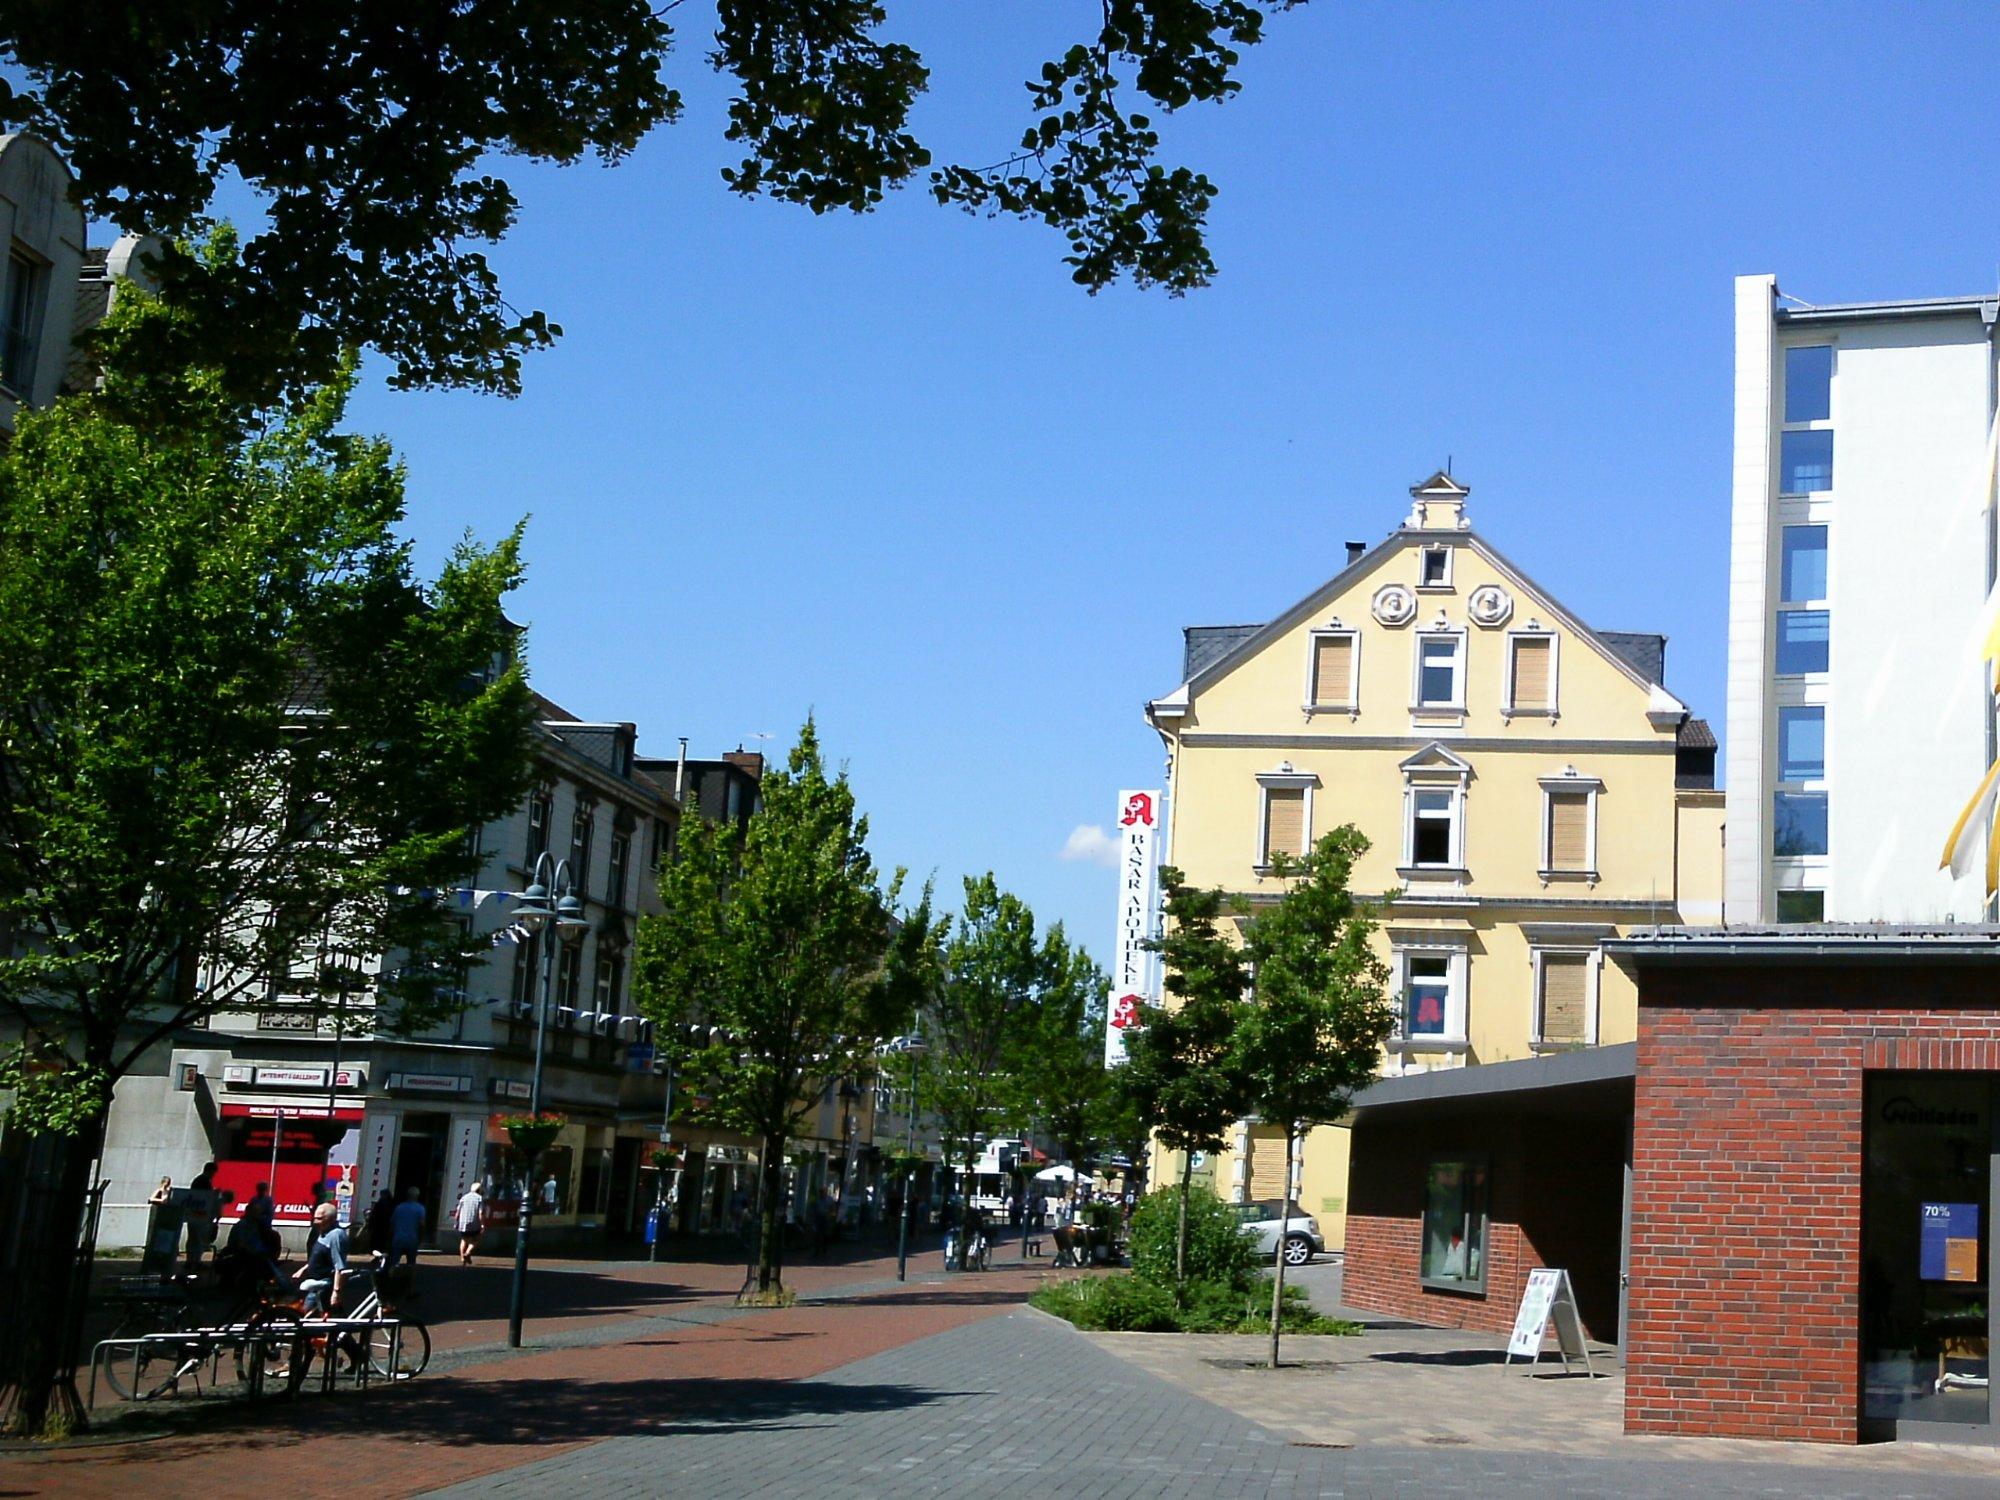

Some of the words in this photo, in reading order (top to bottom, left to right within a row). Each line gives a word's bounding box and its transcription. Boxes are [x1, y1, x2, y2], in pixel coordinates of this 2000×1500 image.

[1128, 834, 1144, 889] BASAR
[1125, 896, 1140, 985] APOTHEKE
[371, 1124, 384, 1202] INTERNE
